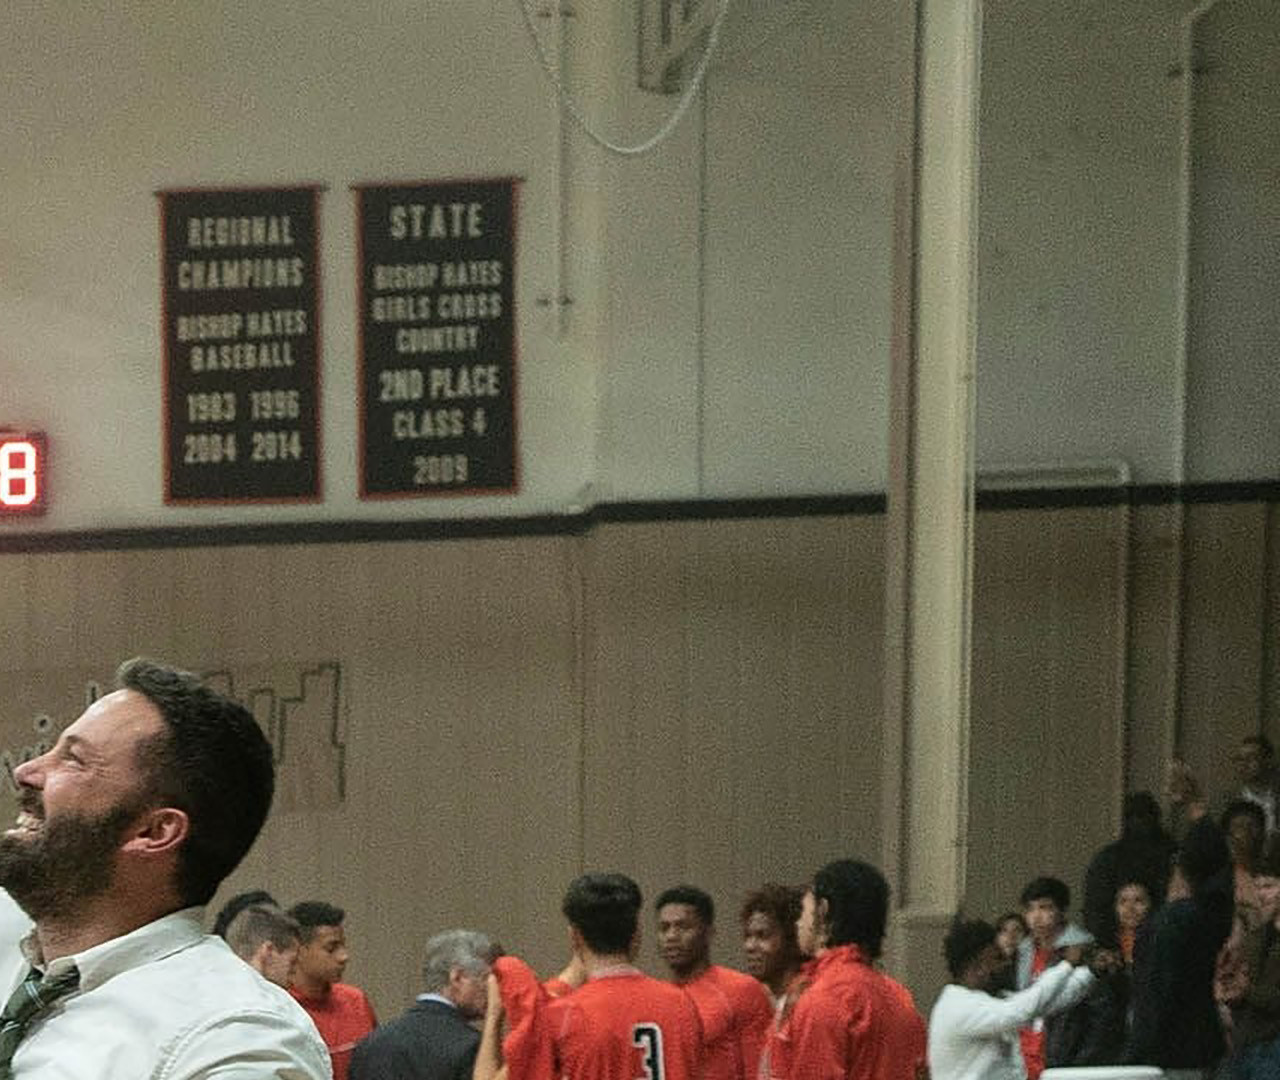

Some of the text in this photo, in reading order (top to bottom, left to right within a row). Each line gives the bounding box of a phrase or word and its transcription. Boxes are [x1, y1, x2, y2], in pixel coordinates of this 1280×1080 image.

[188, 216, 294, 247] REGIONAL
[391, 203, 482, 239] STATE
[178, 258, 304, 290] CHAMPIONS
[373, 260, 502, 290] BISHOP HAYES
[371, 293, 502, 322] GIRLS CROSS
[177, 309, 307, 340] BISHOP HAYES
[396, 326, 479, 353] COUNTRY
[191, 342, 295, 371] BASEBALL
[380, 365, 500, 401] 2ND PLACE
[393, 407, 487, 439] CLASS 4
[251, 431, 302, 461] 2014
[414, 454, 468, 484] 2009
